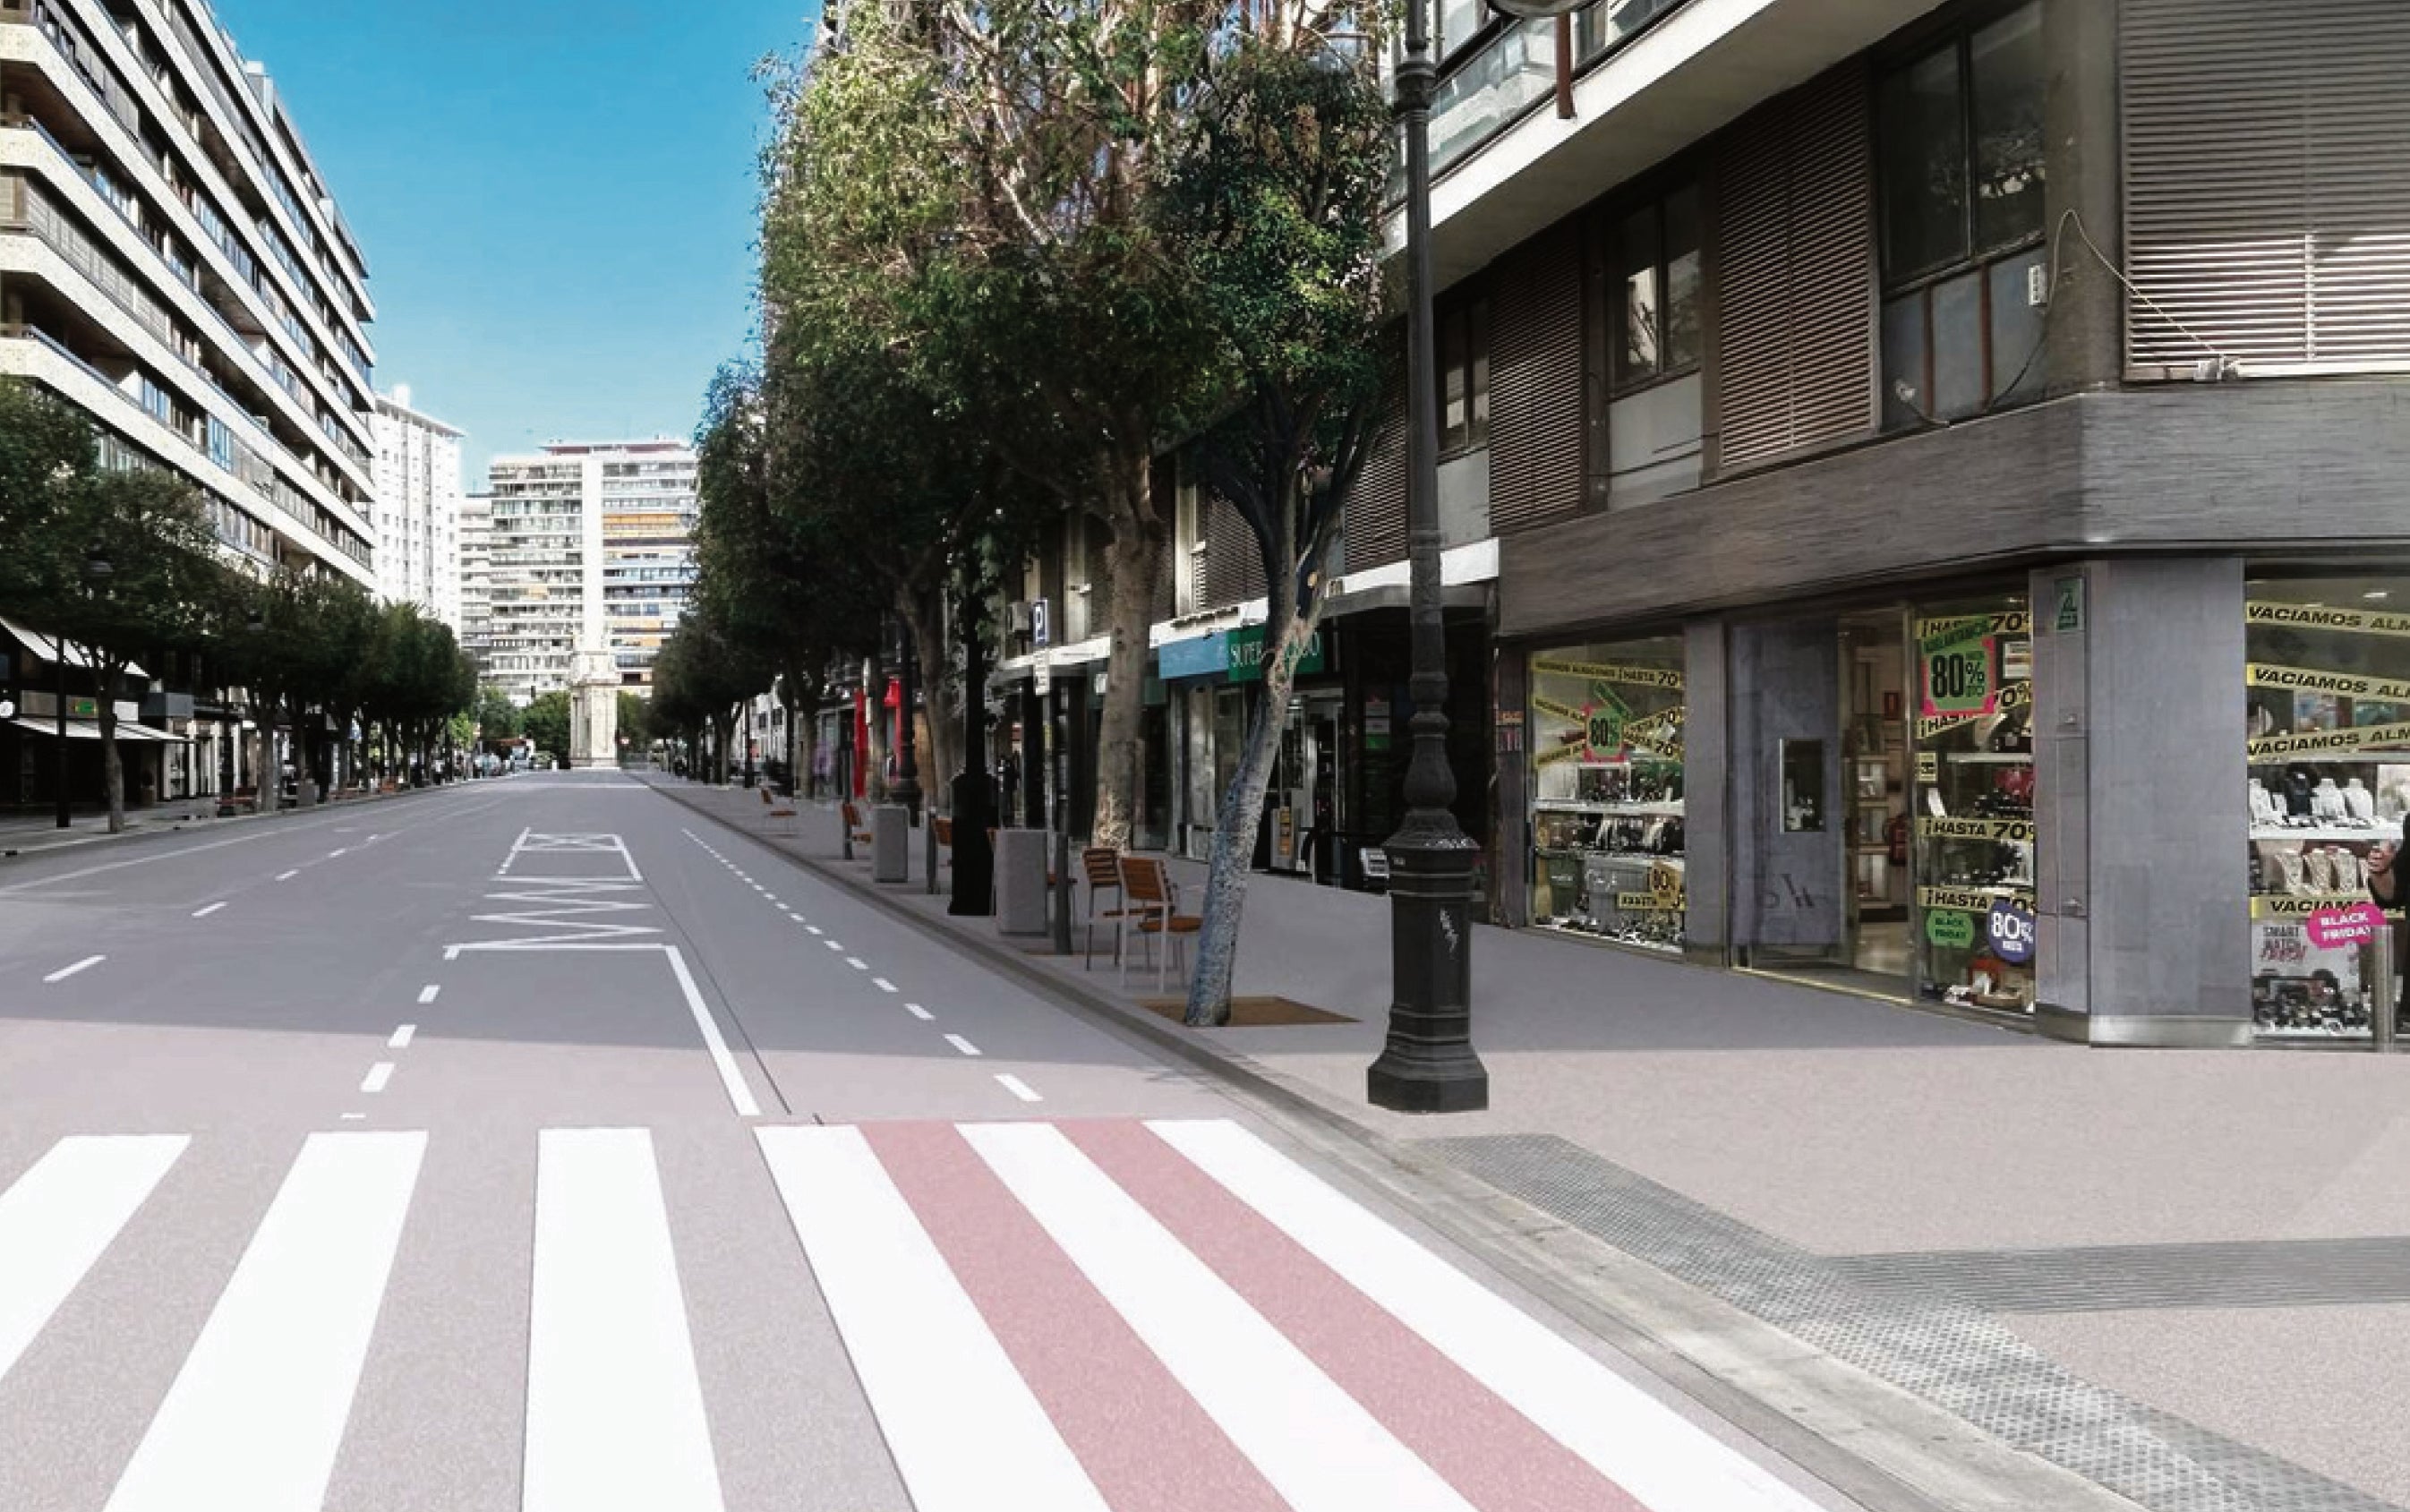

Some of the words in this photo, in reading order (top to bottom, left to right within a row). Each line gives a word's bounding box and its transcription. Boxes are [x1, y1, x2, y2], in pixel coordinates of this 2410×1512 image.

[2248, 605, 2363, 627] VACIAMOS
[2255, 669, 2369, 693] VACIAMOS
[2248, 732, 2360, 756] VACIAMOS
[2320, 911, 2369, 927] BLACK
